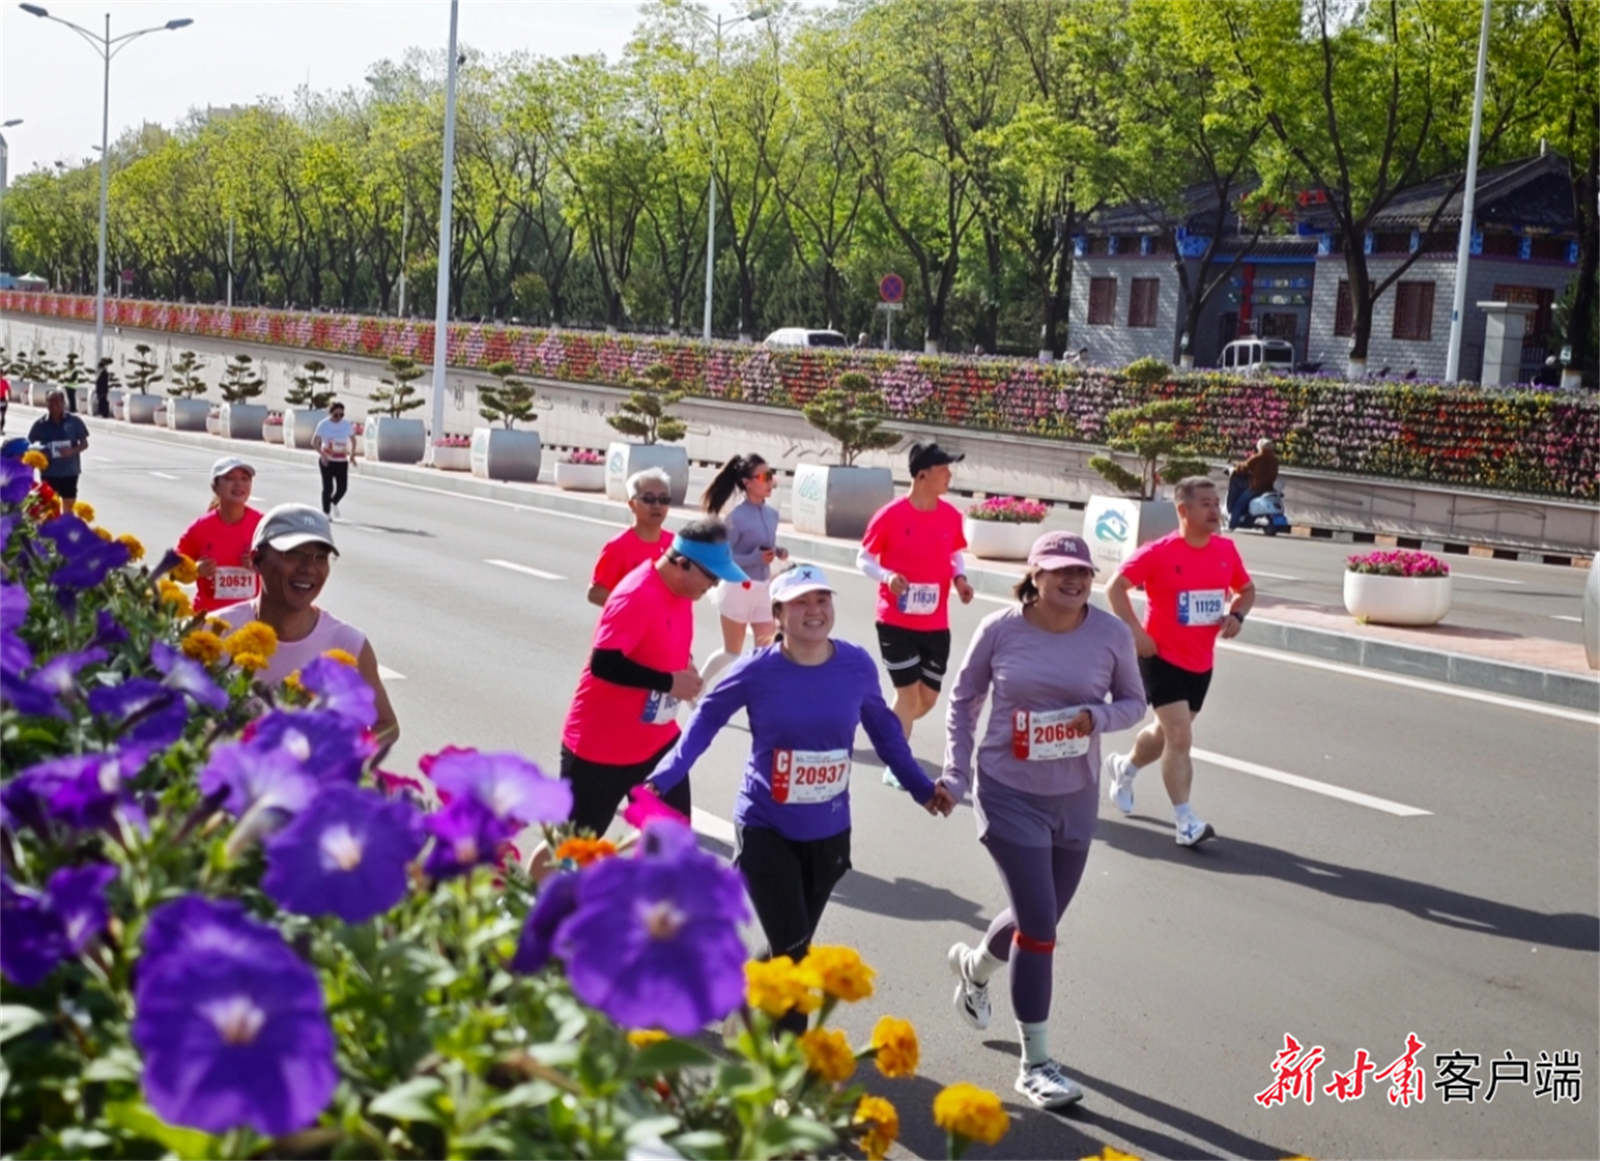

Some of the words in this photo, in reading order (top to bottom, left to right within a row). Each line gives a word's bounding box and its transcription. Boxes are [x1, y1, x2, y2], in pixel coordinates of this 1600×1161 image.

[219, 575, 252, 588] 20621
[1195, 599, 1221, 613] 11129
[1015, 711, 1027, 732] B
[776, 751, 789, 773] C
[795, 763, 846, 785] 20937
